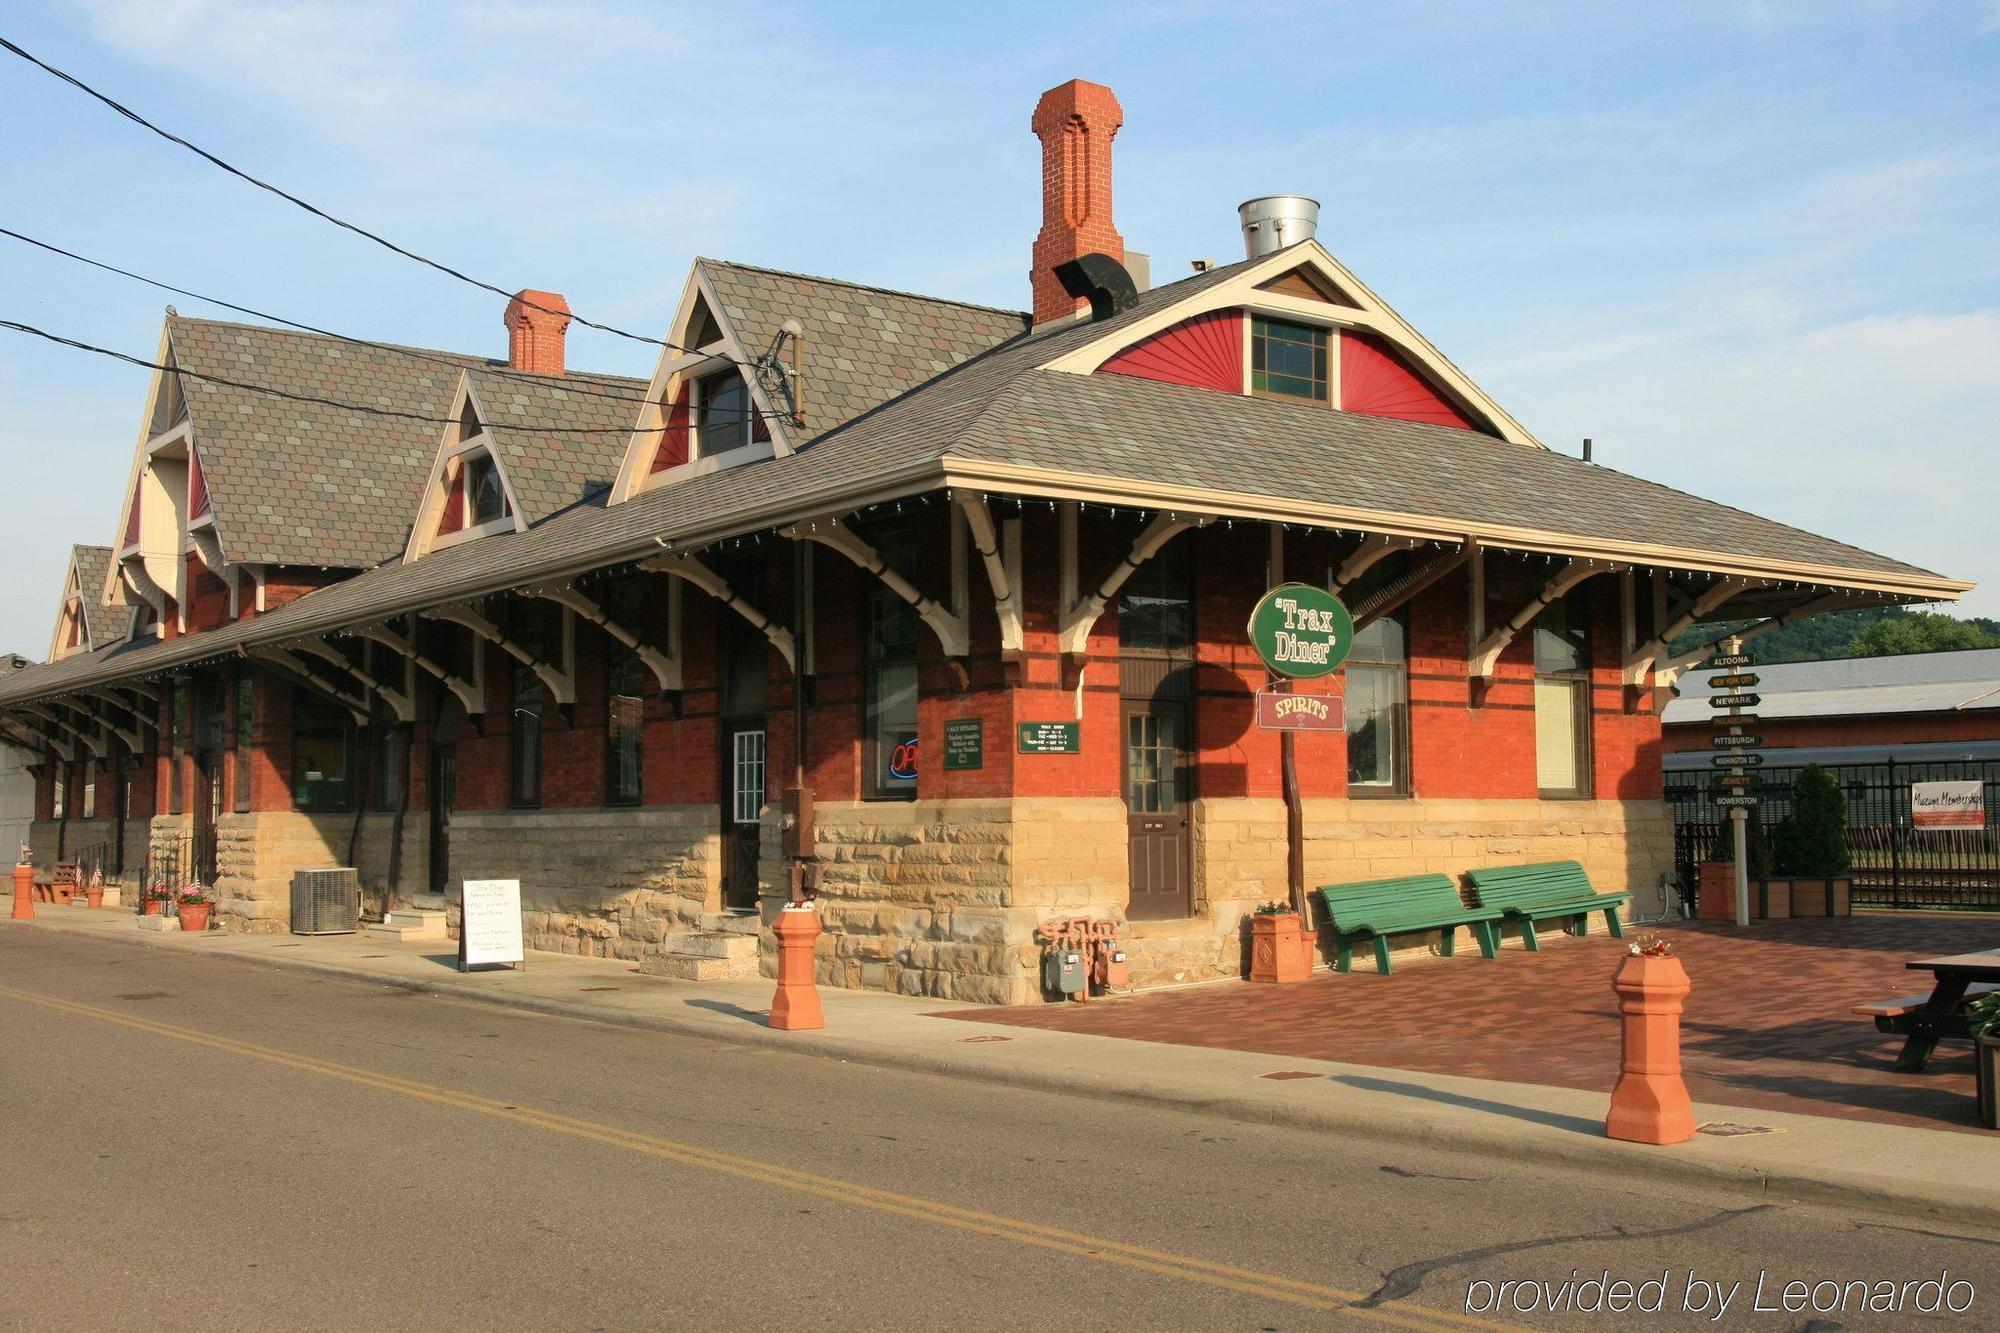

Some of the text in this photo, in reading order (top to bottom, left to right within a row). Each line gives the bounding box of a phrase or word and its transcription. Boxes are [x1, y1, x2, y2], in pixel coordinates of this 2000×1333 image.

[1714, 656, 1749, 666] ALTOONA
[1712, 677, 1725, 686] NEW
[1741, 675, 1753, 684] CITY
[1716, 696, 1752, 706] NEWARK
[1275, 697, 1329, 720] SPIRITS
[1714, 737, 1755, 745] PITTSBURGH
[1716, 756, 1756, 765] WASHINGTON DC
[1717, 797, 1757, 805] BOWERSTON
[1913, 792, 1939, 806] Museum
